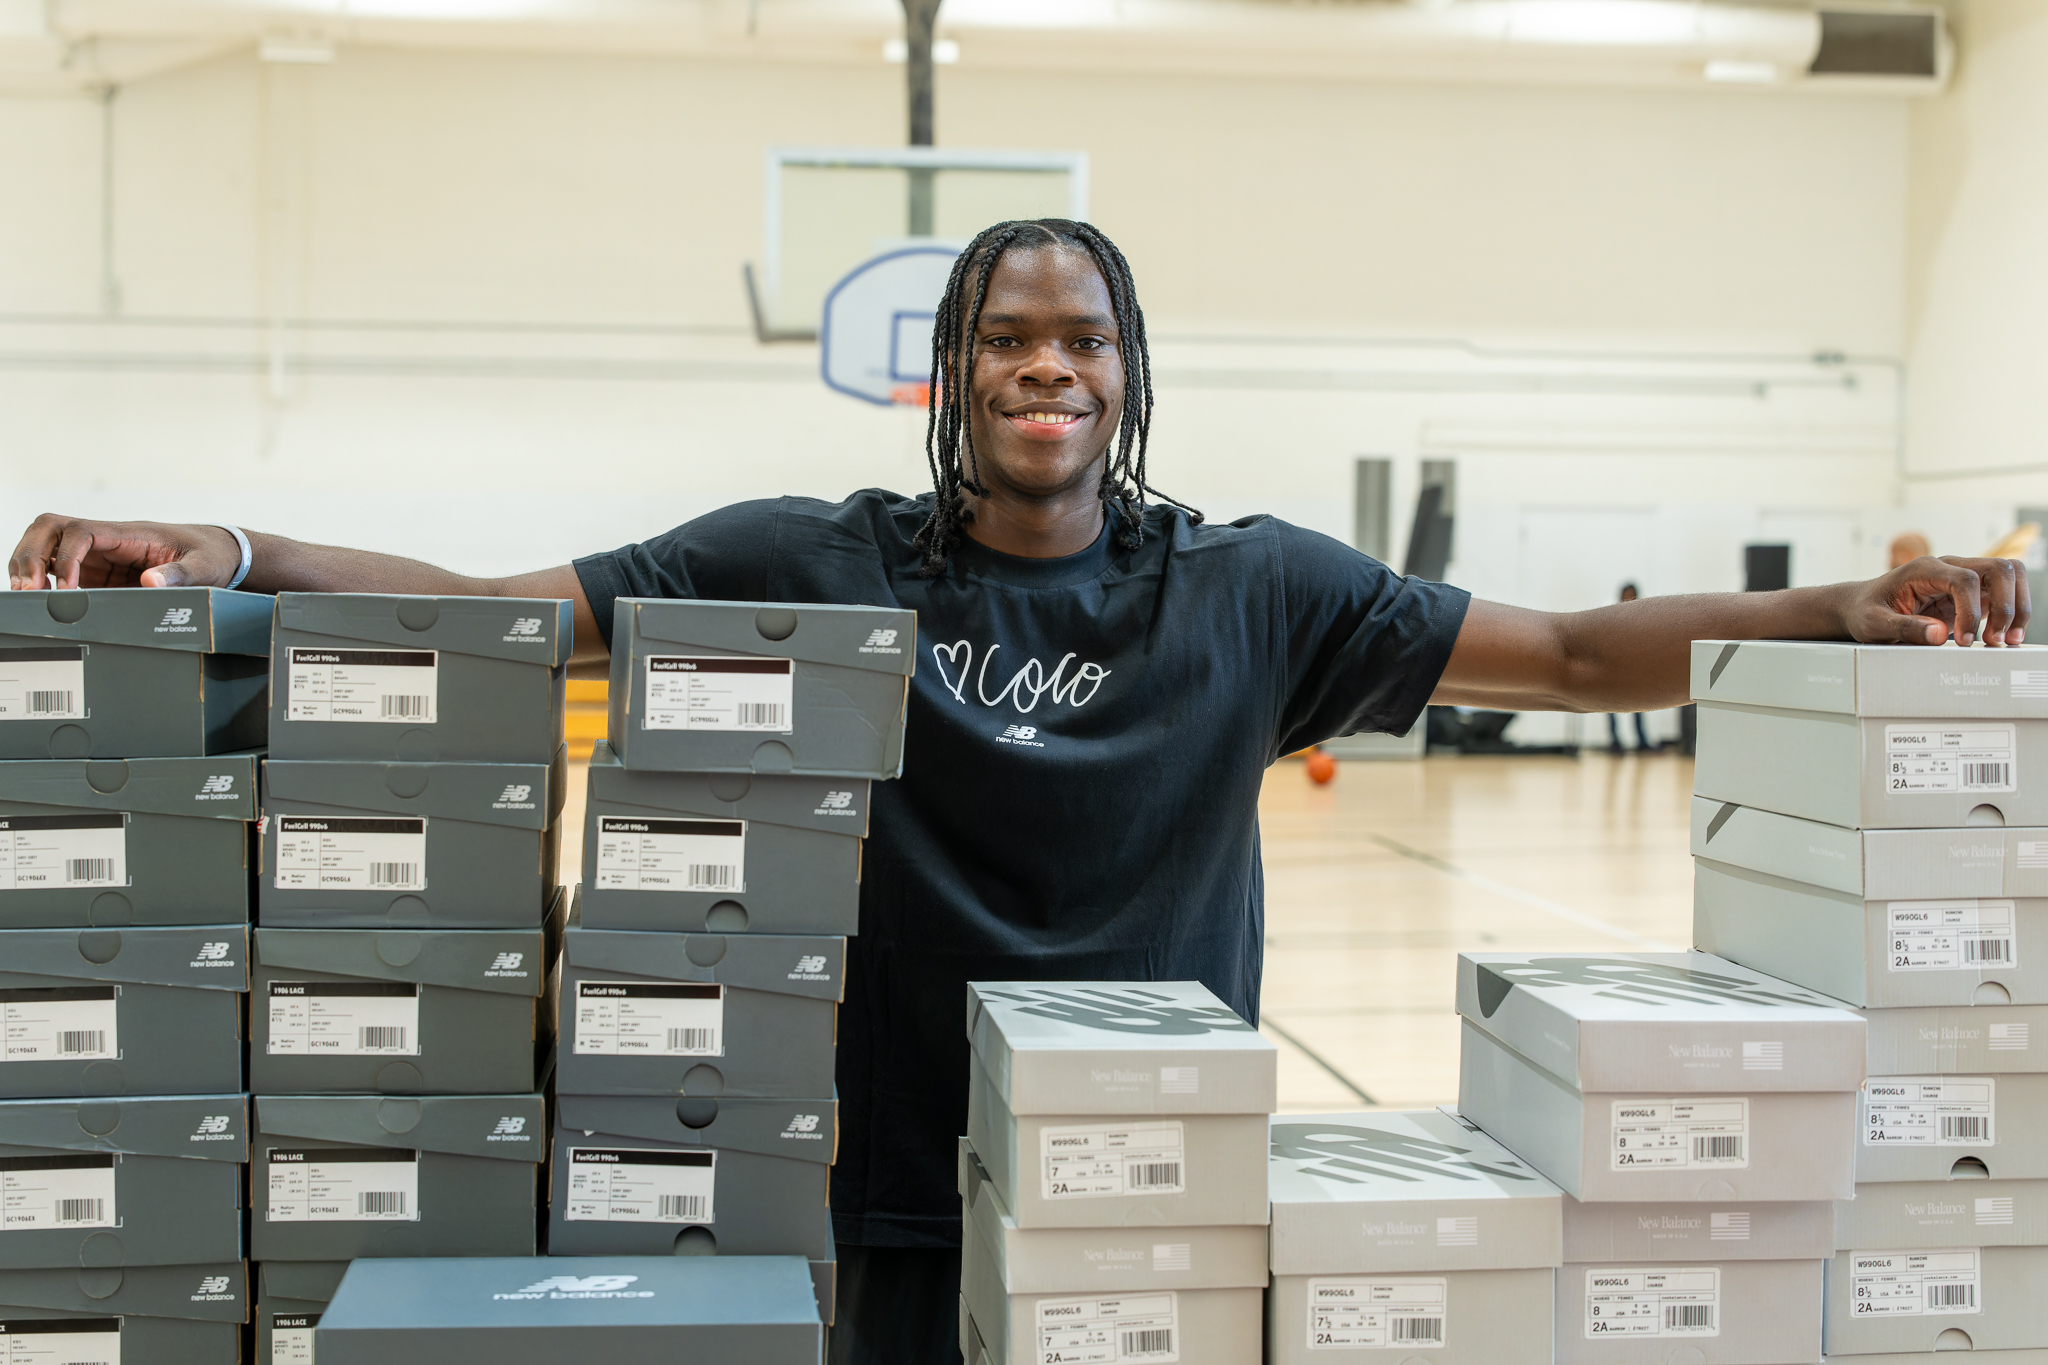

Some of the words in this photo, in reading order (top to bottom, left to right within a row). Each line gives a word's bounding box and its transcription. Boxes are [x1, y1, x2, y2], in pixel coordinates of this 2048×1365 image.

[296, 654, 321, 662] FuelCell
[653, 662, 677, 670] FuelCell
[978, 644, 1112, 713] Coco
[1940, 673, 1960, 686] New
[1963, 672, 2002, 686] Balance
[996, 736, 1012, 744] new
[1012, 738, 1045, 748] balance
[1893, 779, 1908, 789] 2A
[507, 802, 536, 810] balance
[829, 808, 857, 817] balance
[284, 822, 309, 830] FuelCell
[605, 823, 630, 831] FuelCell
[1948, 846, 1970, 858] New
[1971, 844, 2009, 858] Balance
[1895, 956, 1910, 967] 2A
[499, 970, 528, 978] balance
[802, 973, 831, 981] balance
[583, 988, 607, 996] FuelCell
[1919, 1028, 1939, 1040] New
[1941, 1026, 1980, 1040] Balance
[1668, 1044, 1690, 1058] New
[1692, 1044, 1733, 1058] Balance
[1091, 1069, 1111, 1082] New
[1113, 1069, 1152, 1083] Balance
[502, 1134, 531, 1142] balance
[795, 1132, 824, 1140] balance
[1870, 1130, 1885, 1141] 2A
[1619, 1138, 1627, 1148] 8
[288, 1153, 304, 1161] LACE
[576, 1154, 600, 1162] FuelCell
[1619, 1154, 1635, 1164] 2A
[1052, 1167, 1059, 1177] 7
[1052, 1183, 1069, 1194] 2A
[1904, 1203, 1925, 1216] New
[1927, 1202, 1966, 1215] Balance
[1638, 1216, 1658, 1229] New
[1661, 1215, 1701, 1229] Balance
[1362, 1222, 1384, 1236] New
[1386, 1221, 1428, 1236] Balance
[1084, 1249, 1104, 1262] New
[1106, 1248, 1144, 1262] Balance
[550, 1291, 655, 1300] balance
[1593, 1306, 1600, 1316] 8
[1857, 1302, 1873, 1313] 2A
[291, 1318, 307, 1326] LACE
[1593, 1322, 1608, 1332] 2A
[1045, 1337, 1052, 1347] 7
[1317, 1334, 1333, 1344] 2A
[1045, 1352, 1062, 1364] 2A
